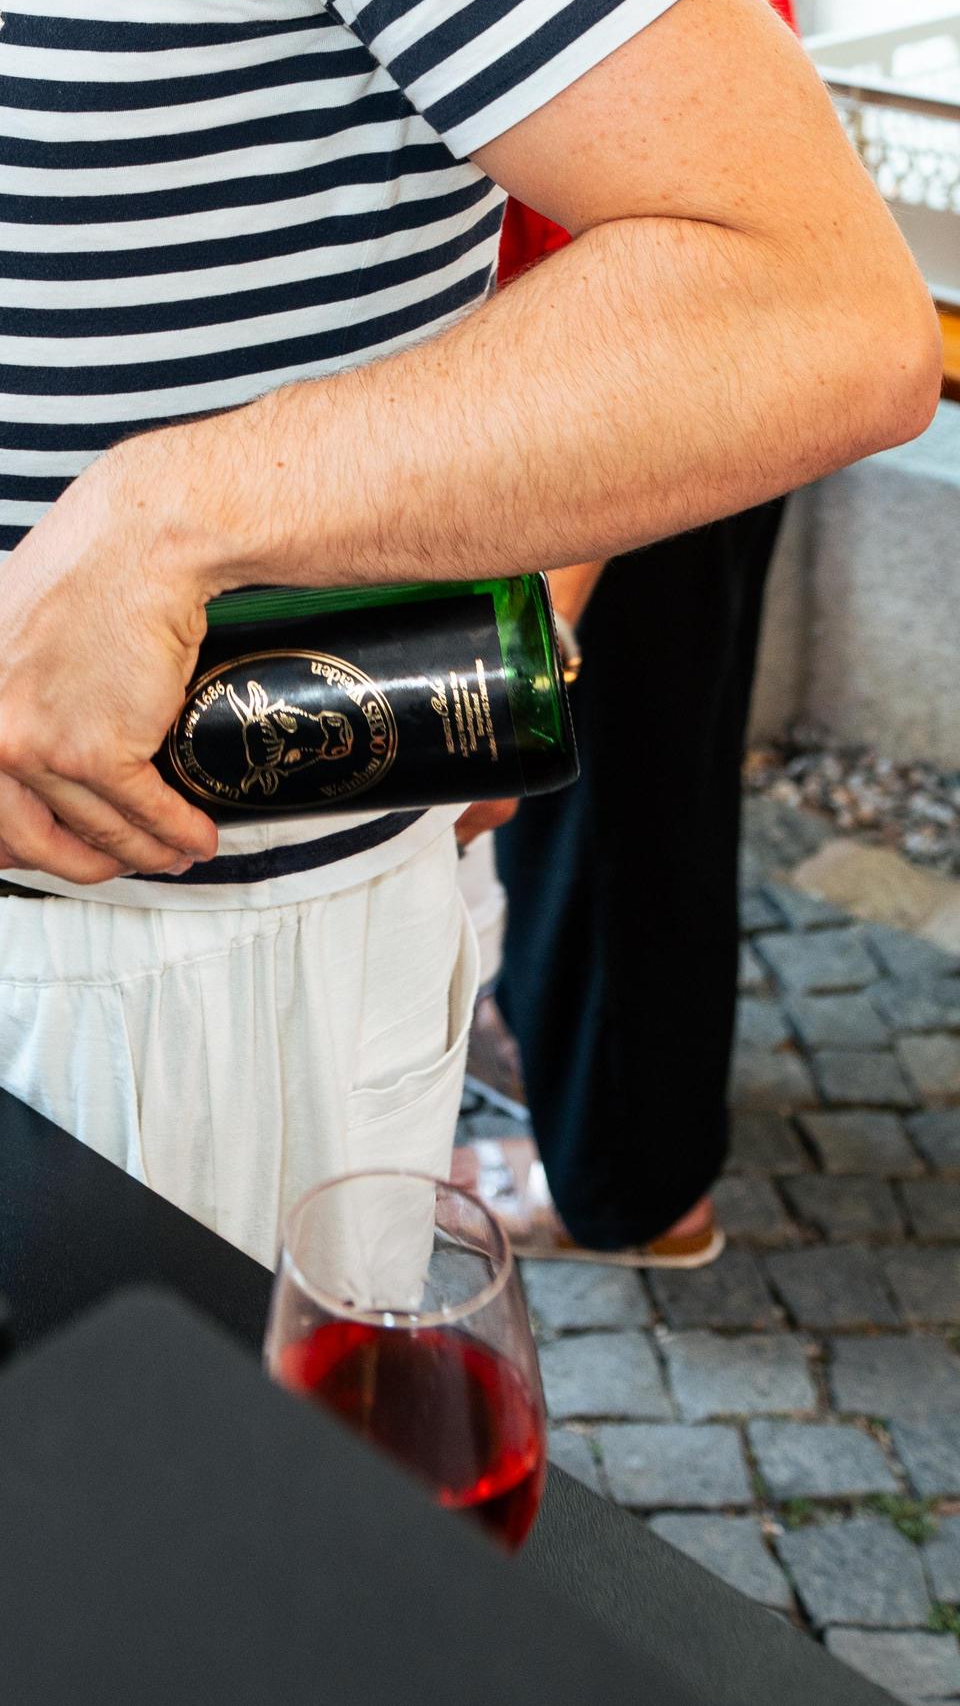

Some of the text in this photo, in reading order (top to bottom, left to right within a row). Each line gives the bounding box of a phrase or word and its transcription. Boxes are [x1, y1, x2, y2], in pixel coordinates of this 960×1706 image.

[195, 680, 226, 711] 1686
[311, 661, 387, 797] Weinbau OCHS Weiden
